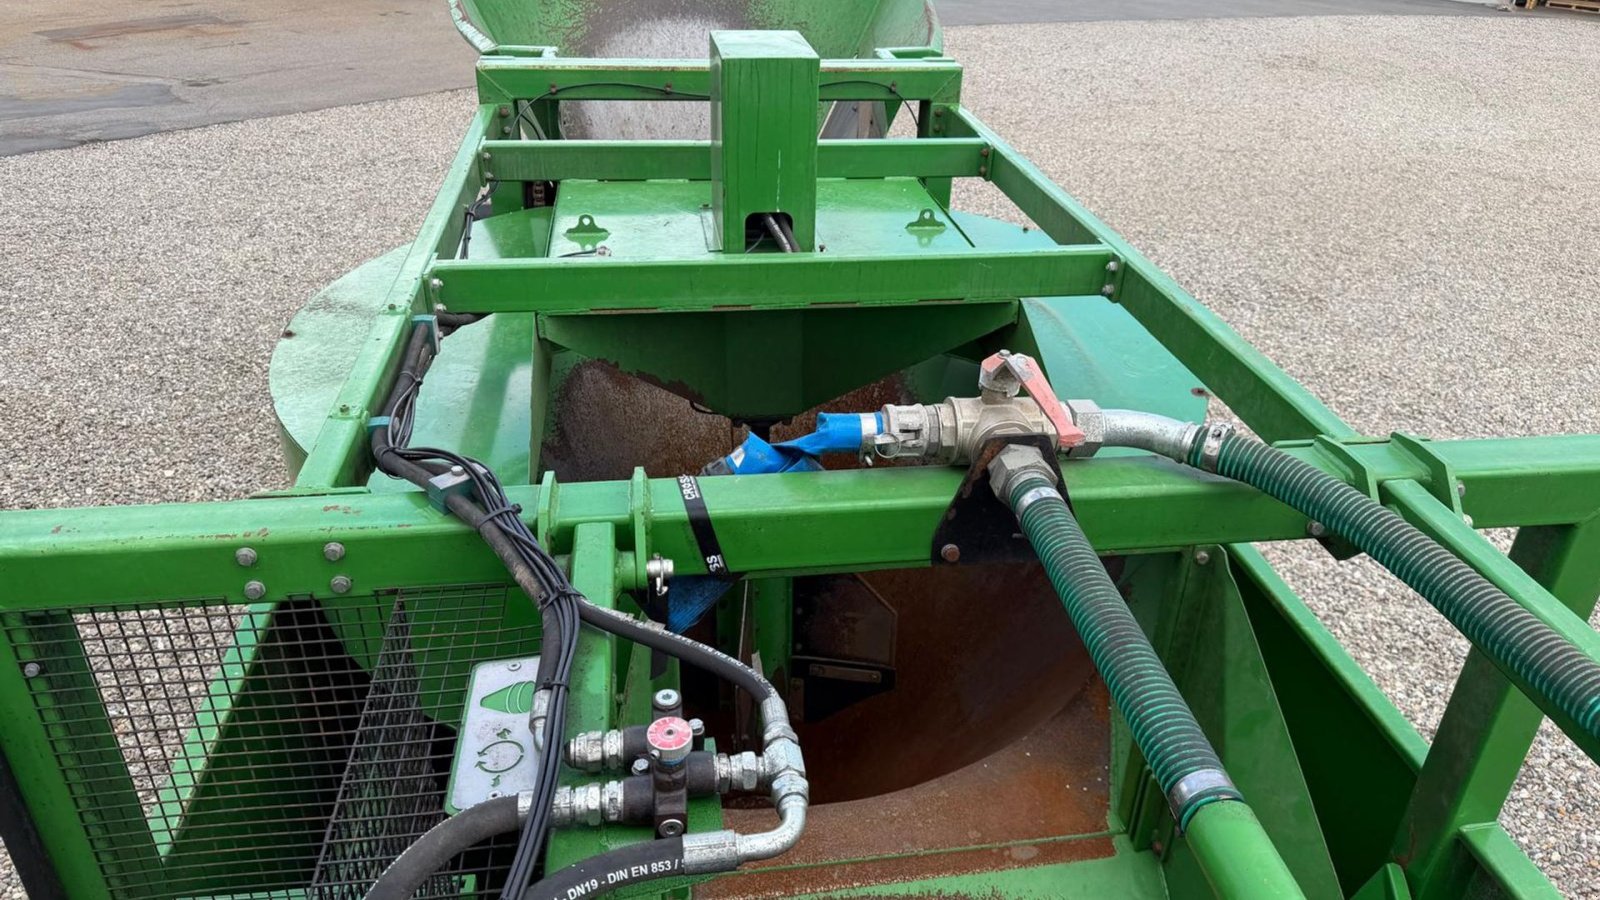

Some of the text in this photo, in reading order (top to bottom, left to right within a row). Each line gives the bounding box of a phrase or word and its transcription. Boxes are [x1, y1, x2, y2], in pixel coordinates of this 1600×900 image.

[567, 879, 598, 900] DN19
[607, 869, 629, 884] DIN
[631, 864, 649, 878] EN
[651, 860, 671, 873] 853
[674, 858, 679, 870] /
